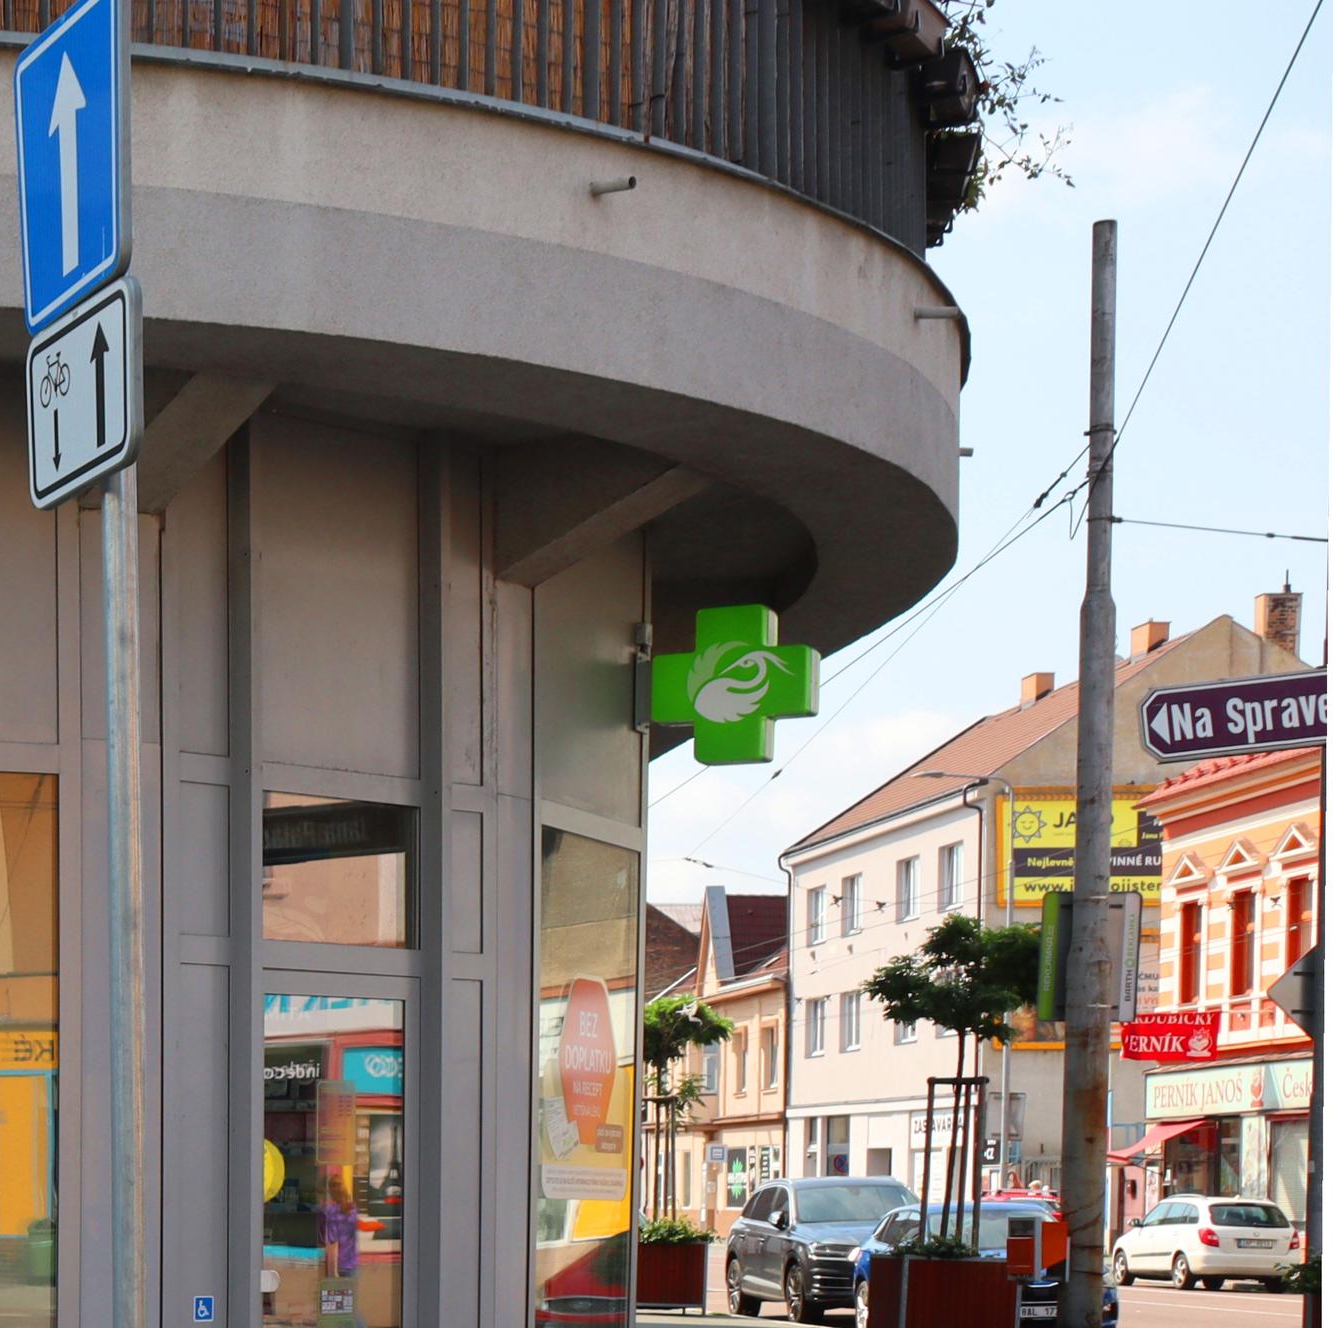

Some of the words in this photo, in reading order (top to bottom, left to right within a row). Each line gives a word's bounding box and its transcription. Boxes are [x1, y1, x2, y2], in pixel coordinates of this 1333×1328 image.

[1170, 702, 1214, 742] Na
[1110, 854, 1142, 867] INNÉ
[579, 1011, 598, 1038] BEZ
[1125, 1032, 1185, 1053] ERNÍK
[565, 1044, 612, 1074] DOPLATKU
[1153, 1078, 1199, 1109] PERNÍK
[1200, 1073, 1243, 1111] JANOŠ
